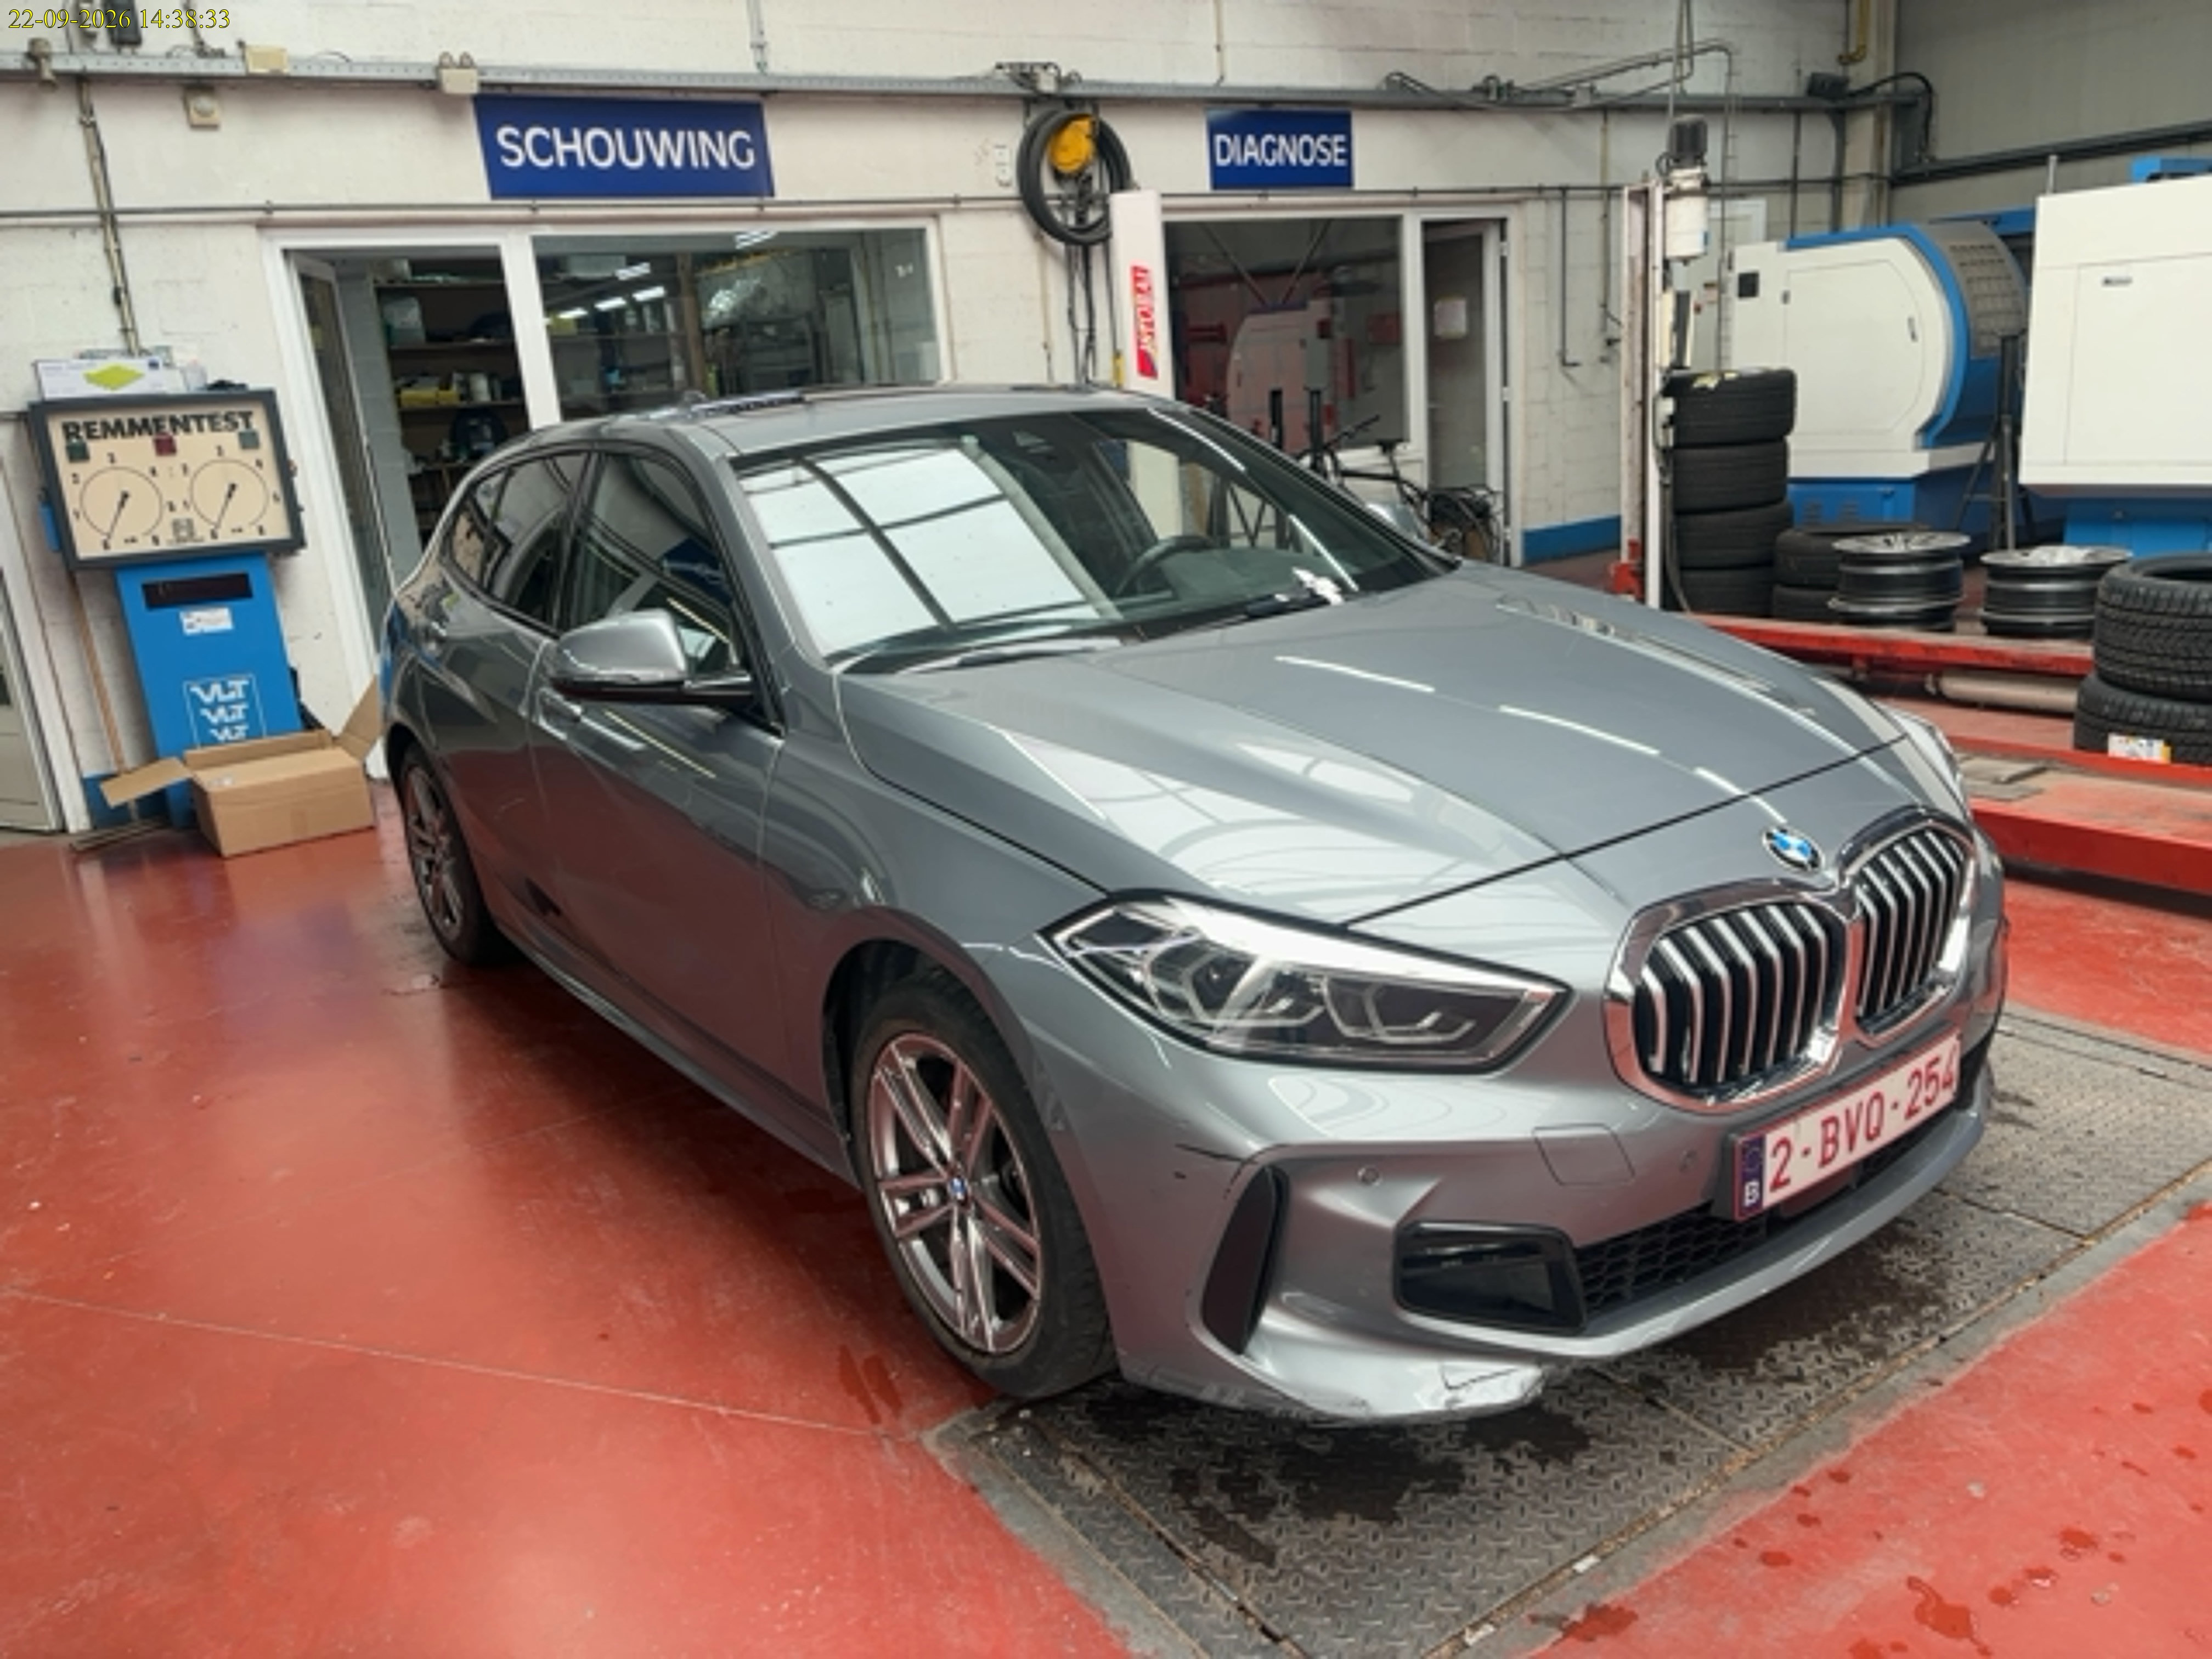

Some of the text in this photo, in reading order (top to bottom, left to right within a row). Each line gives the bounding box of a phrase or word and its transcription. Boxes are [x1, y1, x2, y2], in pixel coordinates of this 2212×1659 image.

[496, 126, 755, 168] SCHOUWING
[1215, 134, 1347, 166] DIAGNOSE
[61, 411, 253, 440] REMMENTEST
